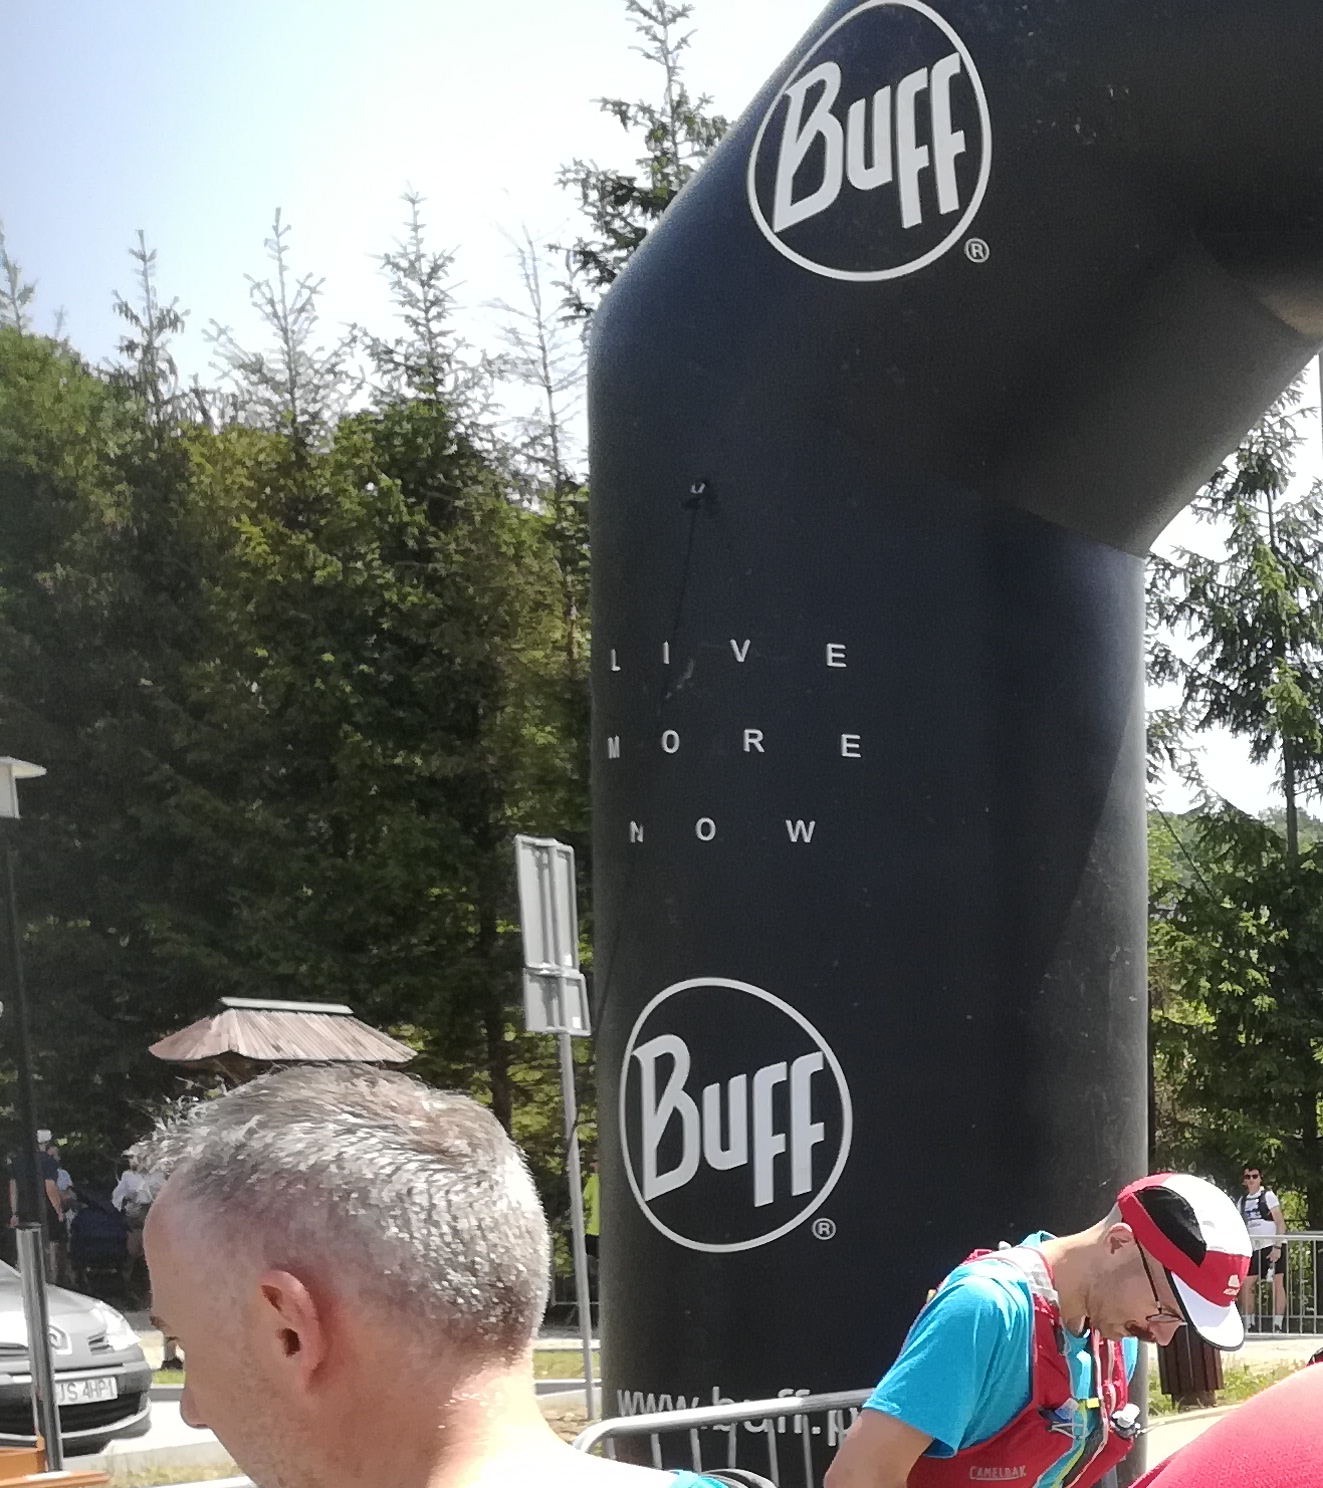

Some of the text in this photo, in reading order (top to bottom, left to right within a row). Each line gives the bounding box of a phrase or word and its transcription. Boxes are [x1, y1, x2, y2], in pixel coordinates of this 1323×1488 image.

[611, 639, 847, 672] LIVE
[608, 728, 862, 759] MORE
[630, 817, 816, 843] NOW
[969, 1465, 1027, 1480] CAMELBAK
